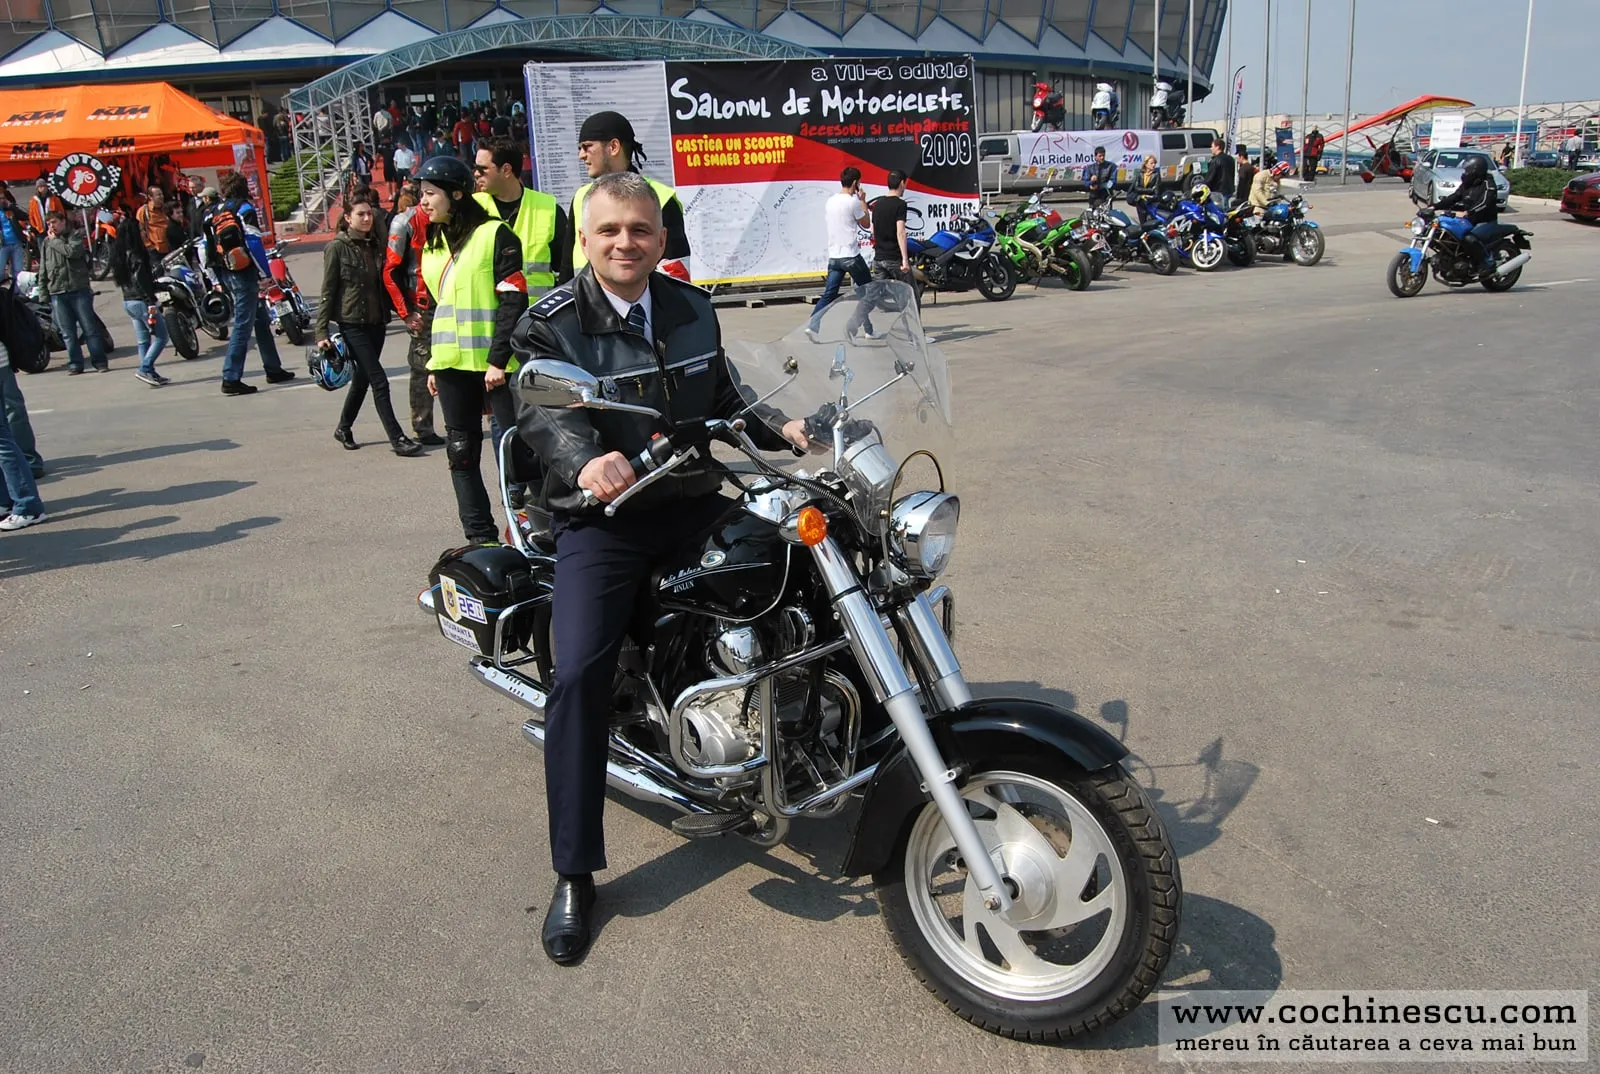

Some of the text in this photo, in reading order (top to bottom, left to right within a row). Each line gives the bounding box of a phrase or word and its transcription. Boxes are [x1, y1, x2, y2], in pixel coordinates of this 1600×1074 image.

[811, 67, 828, 81] a
[670, 77, 970, 123] Salonul de Motociclete,
[5, 109, 68, 122] KTM
[86, 112, 150, 120] RACING
[92, 105, 151, 116] KTM
[1, 116, 63, 127] RACING
[184, 130, 219, 141] KTM
[800, 121, 864, 137] accesorii
[11, 142, 49, 154] KTM
[98, 136, 136, 149] KTM
[181, 138, 220, 147] RACING
[725, 138, 742, 151] UN
[744, 135, 794, 151] SCOOTER
[96, 145, 136, 154] RACING
[920, 132, 972, 167] 2009
[55, 153, 104, 177] MOTO
[686, 150, 786, 167] LA SMAEB 2009!!!
[1031, 154, 1046, 166] All
[1048, 153, 1072, 164] Ride
[1122, 154, 1142, 163] SYM
[928, 203, 948, 219] PRET
